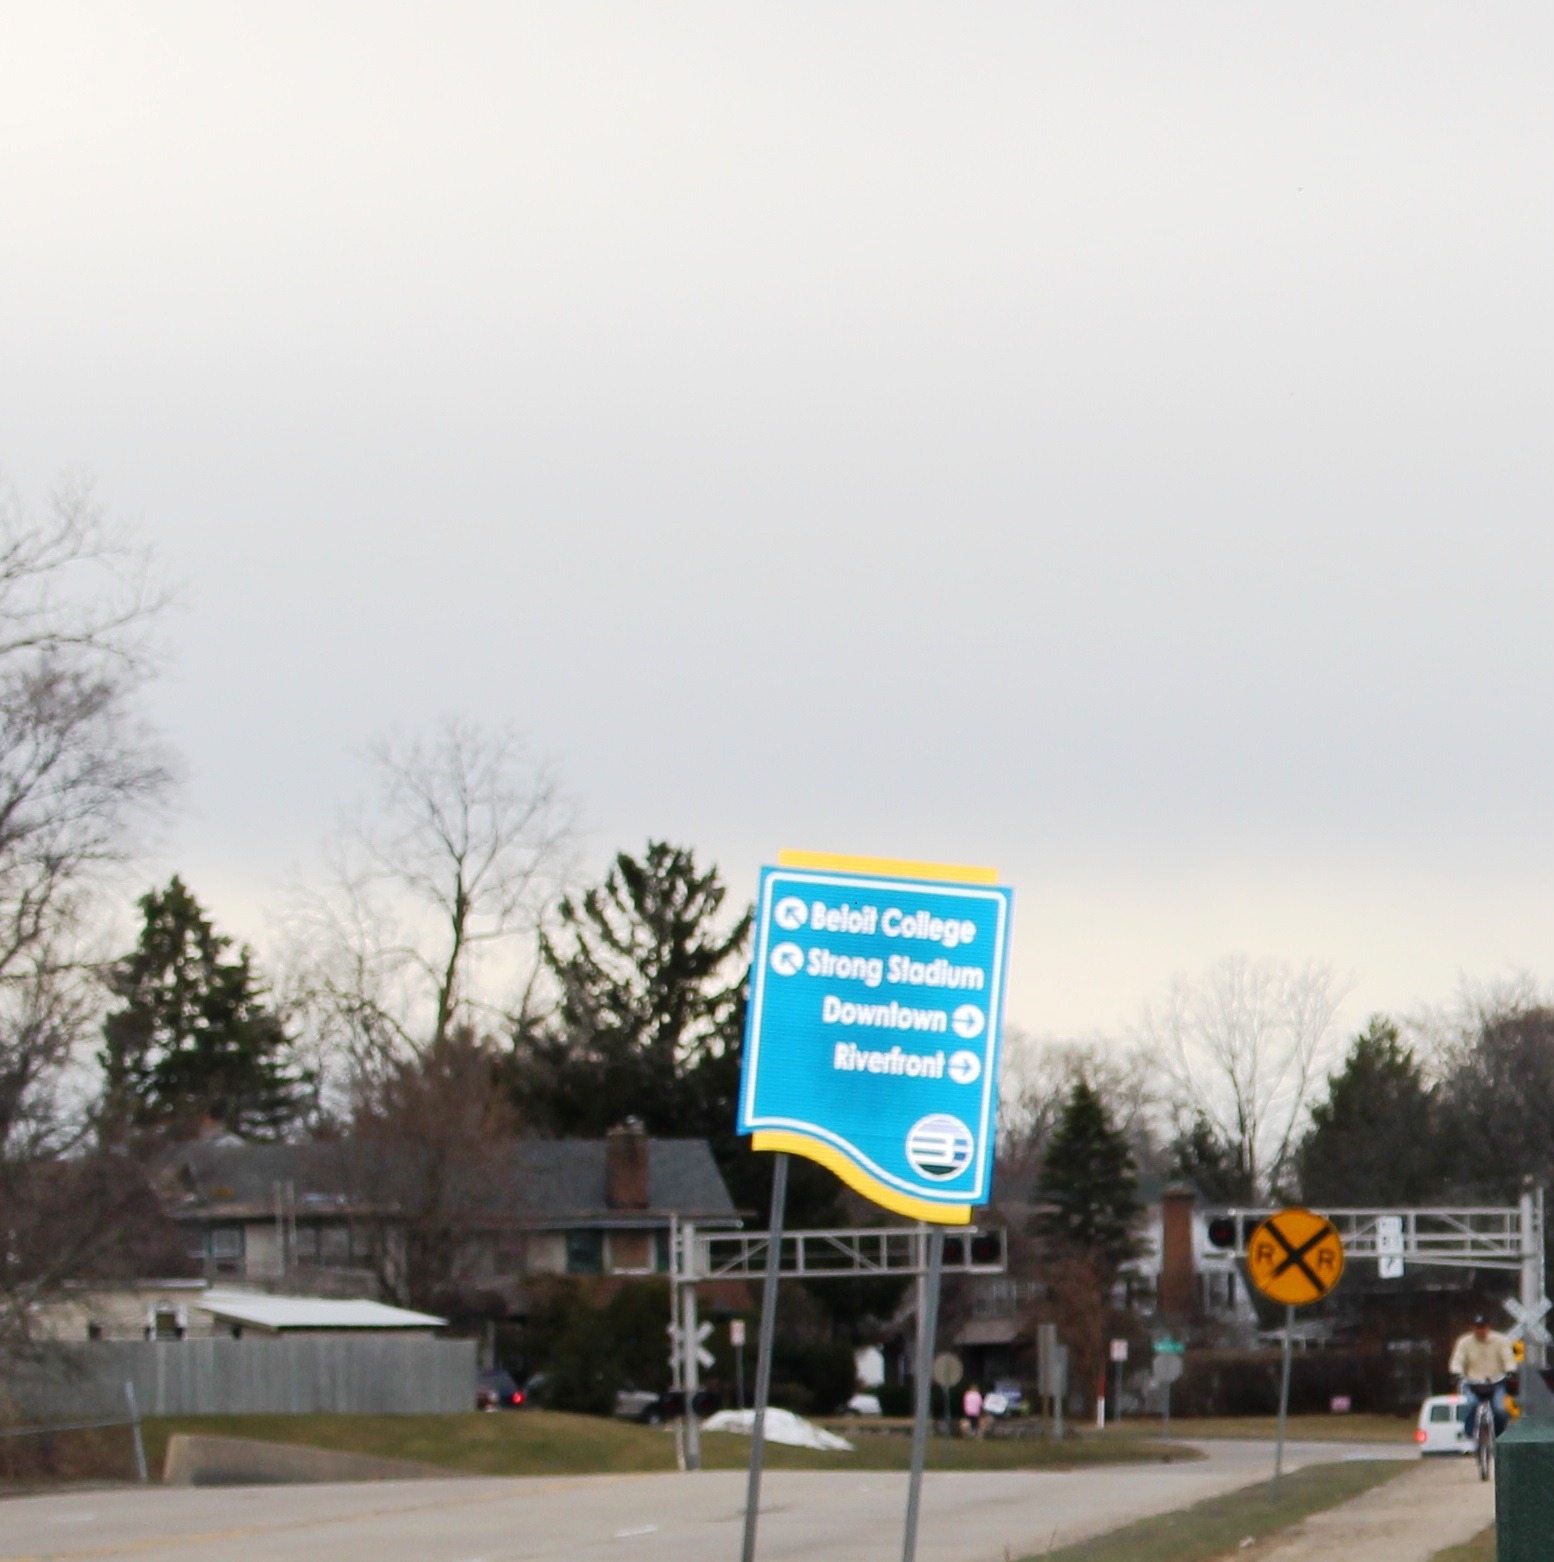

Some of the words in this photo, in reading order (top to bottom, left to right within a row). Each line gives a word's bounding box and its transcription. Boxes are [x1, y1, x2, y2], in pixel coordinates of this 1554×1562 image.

[809, 901, 878, 935] Beloit
[881, 907, 977, 947] College
[805, 947, 884, 987] Strong
[886, 951, 985, 990] Stadium
[822, 995, 948, 1032] Downtown
[833, 1042, 946, 1079] Riverfront
[1256, 1243, 1275, 1265] R
[1317, 1248, 1335, 1270] R
